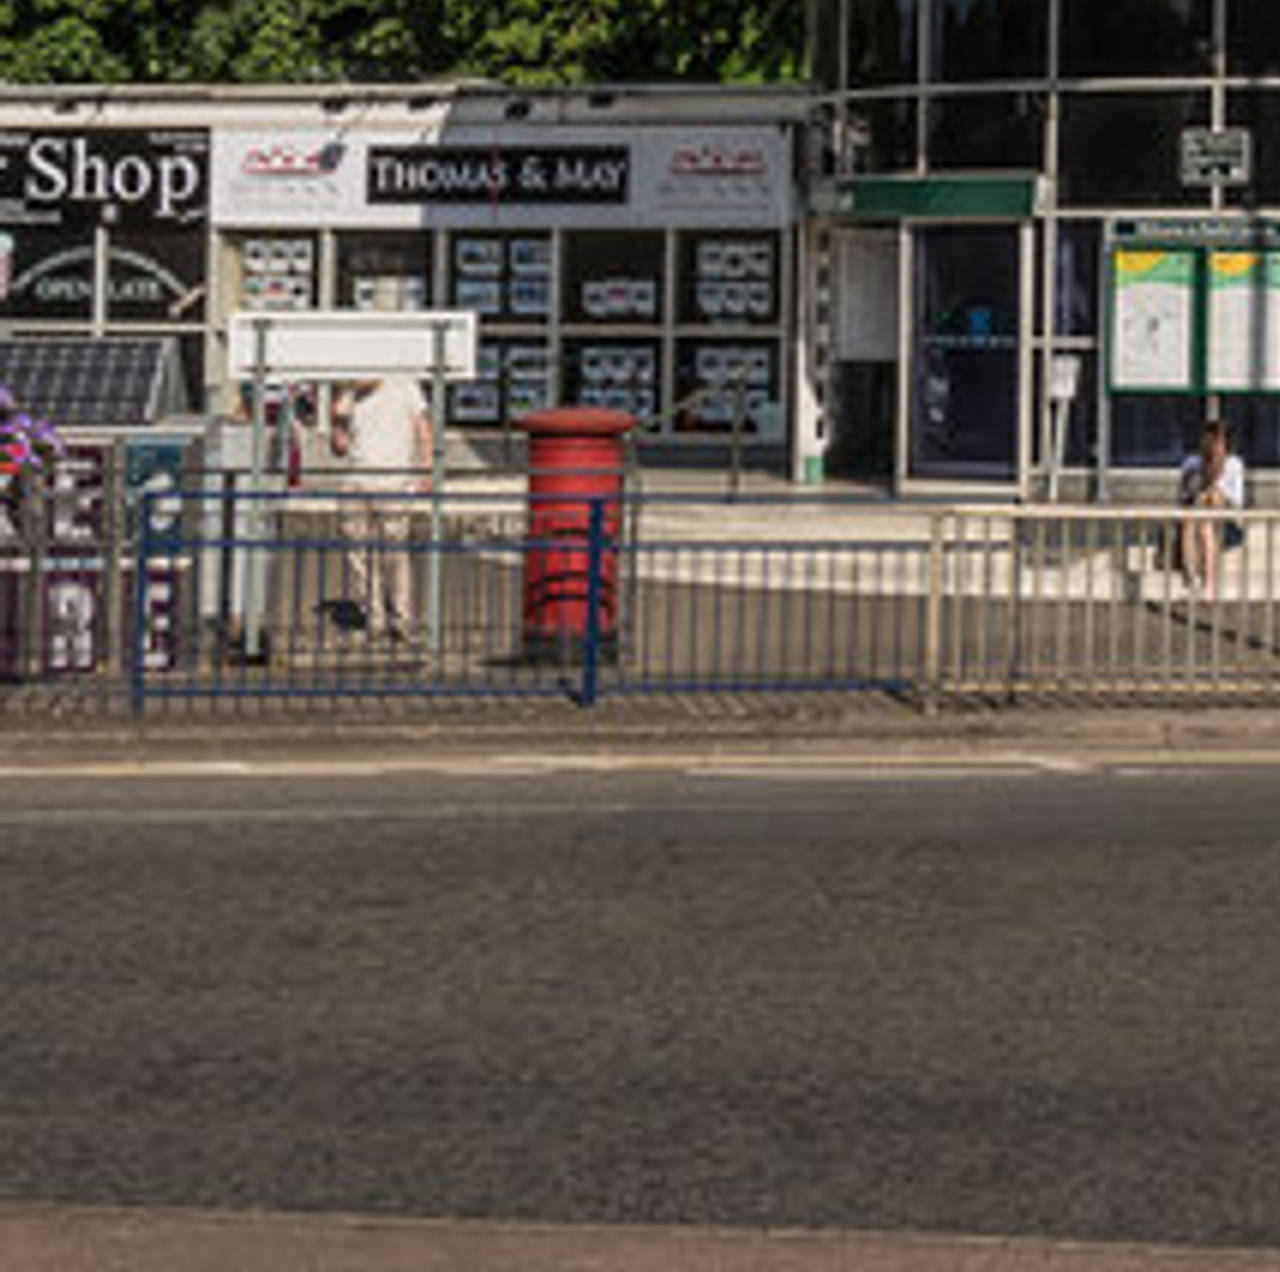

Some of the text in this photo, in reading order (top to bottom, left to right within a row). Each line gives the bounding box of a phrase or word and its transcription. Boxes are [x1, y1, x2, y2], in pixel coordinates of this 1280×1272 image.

[25, 138, 199, 218] Shop
[374, 156, 509, 191] THOMAS
[517, 156, 548, 191] &
